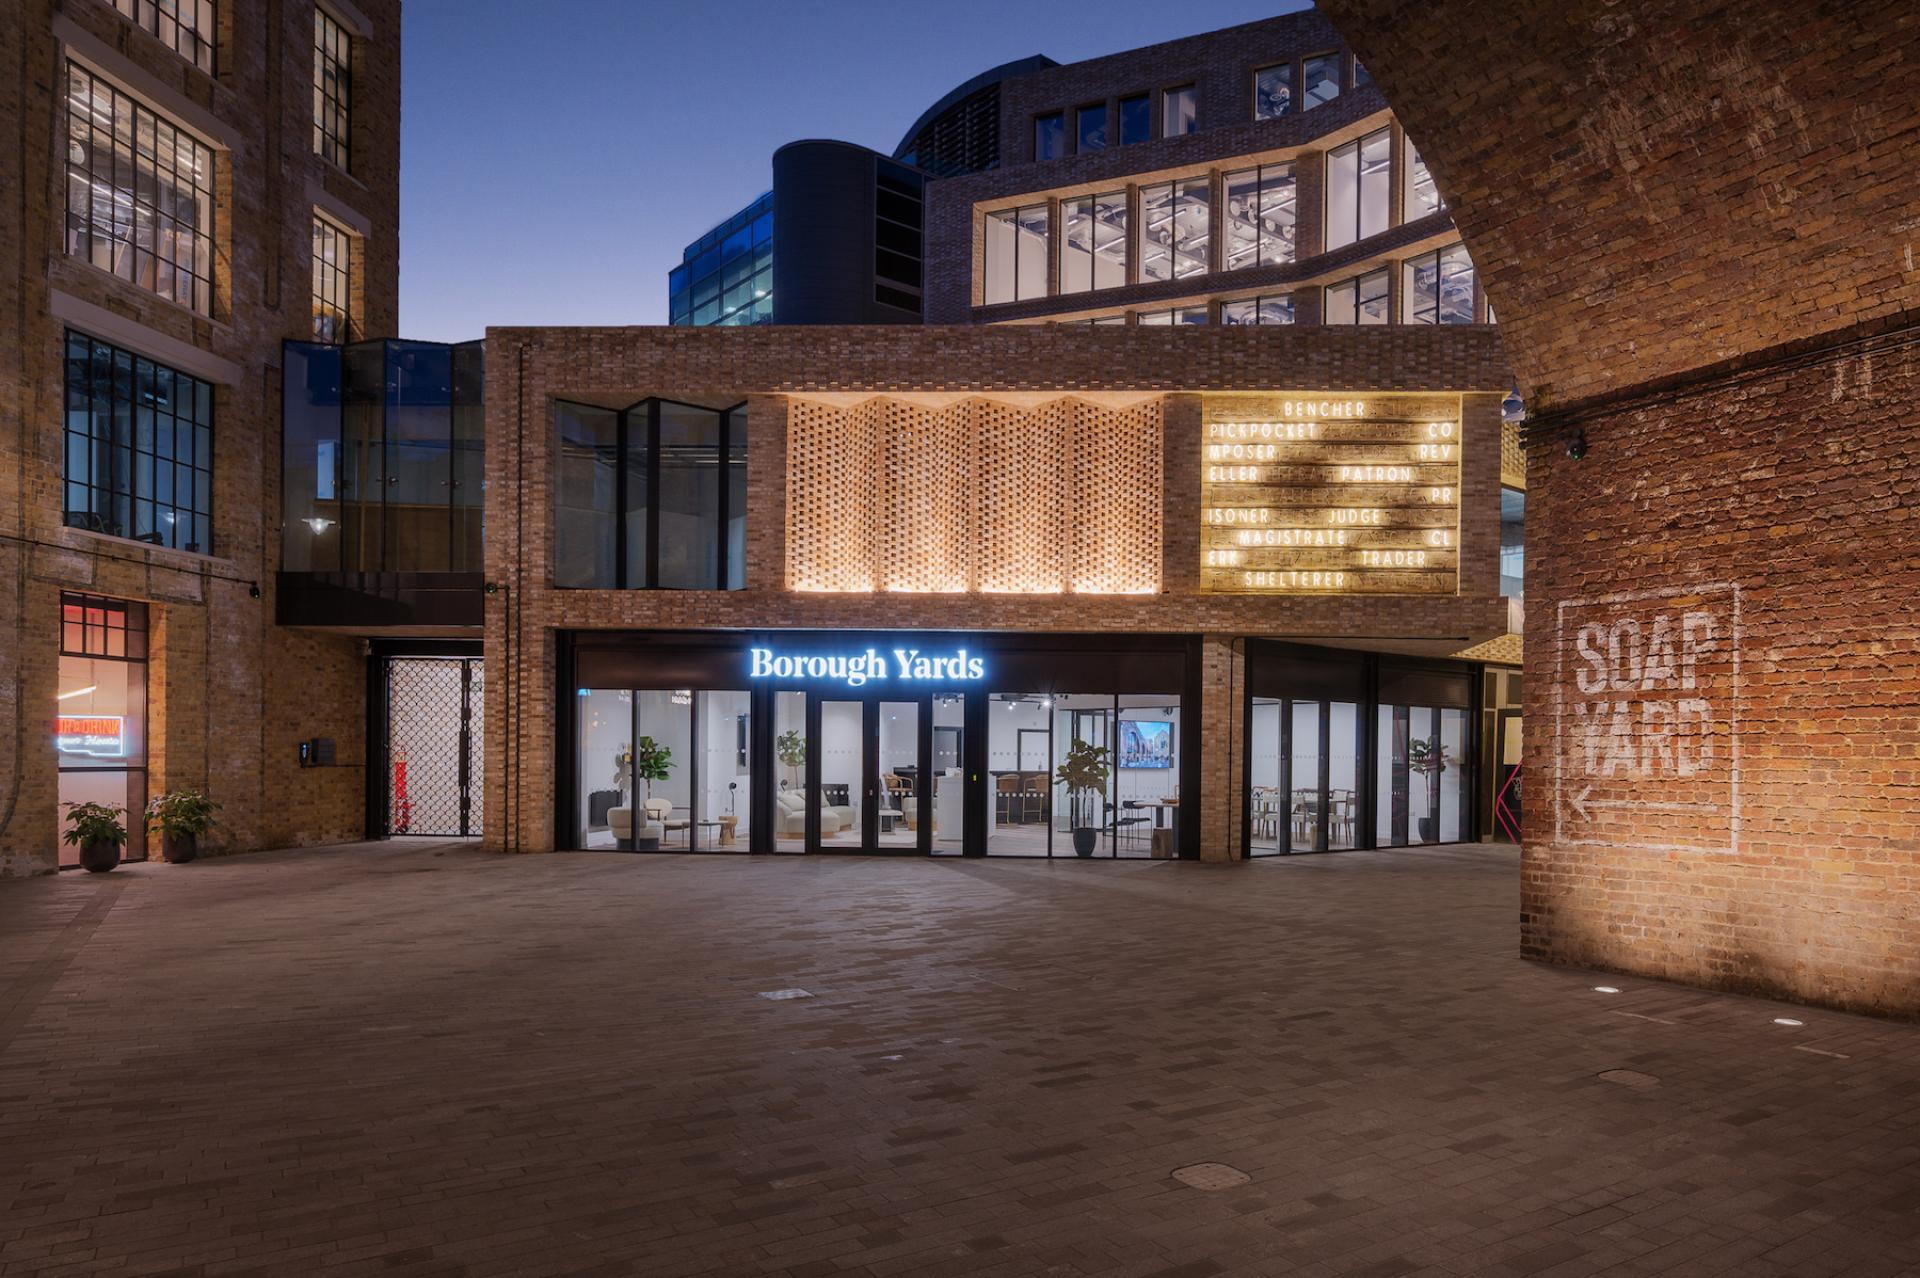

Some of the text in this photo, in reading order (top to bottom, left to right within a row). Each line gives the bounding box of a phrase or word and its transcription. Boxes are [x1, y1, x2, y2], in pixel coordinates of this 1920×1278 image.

[1284, 401, 1364, 417] BENCHER
[1210, 422, 1452, 438] PICKPOCKET CO
[1209, 444, 1451, 459] MPOSER REV
[1210, 466, 1258, 481] ELLER
[1341, 466, 1410, 481] PATRON
[1432, 487, 1451, 502] PR
[1209, 508, 1380, 523] ISONER JUDGE
[1239, 530, 1450, 545] MAGISTRATE CL
[1208, 551, 1425, 566] ERK TRADER
[1245, 571, 1344, 586] SHELTERER
[1575, 611, 1719, 694] SOAP
[750, 648, 984, 687] Borough Yards
[82, 719, 119, 736] DRINK
[1573, 698, 1714, 777] YARD
